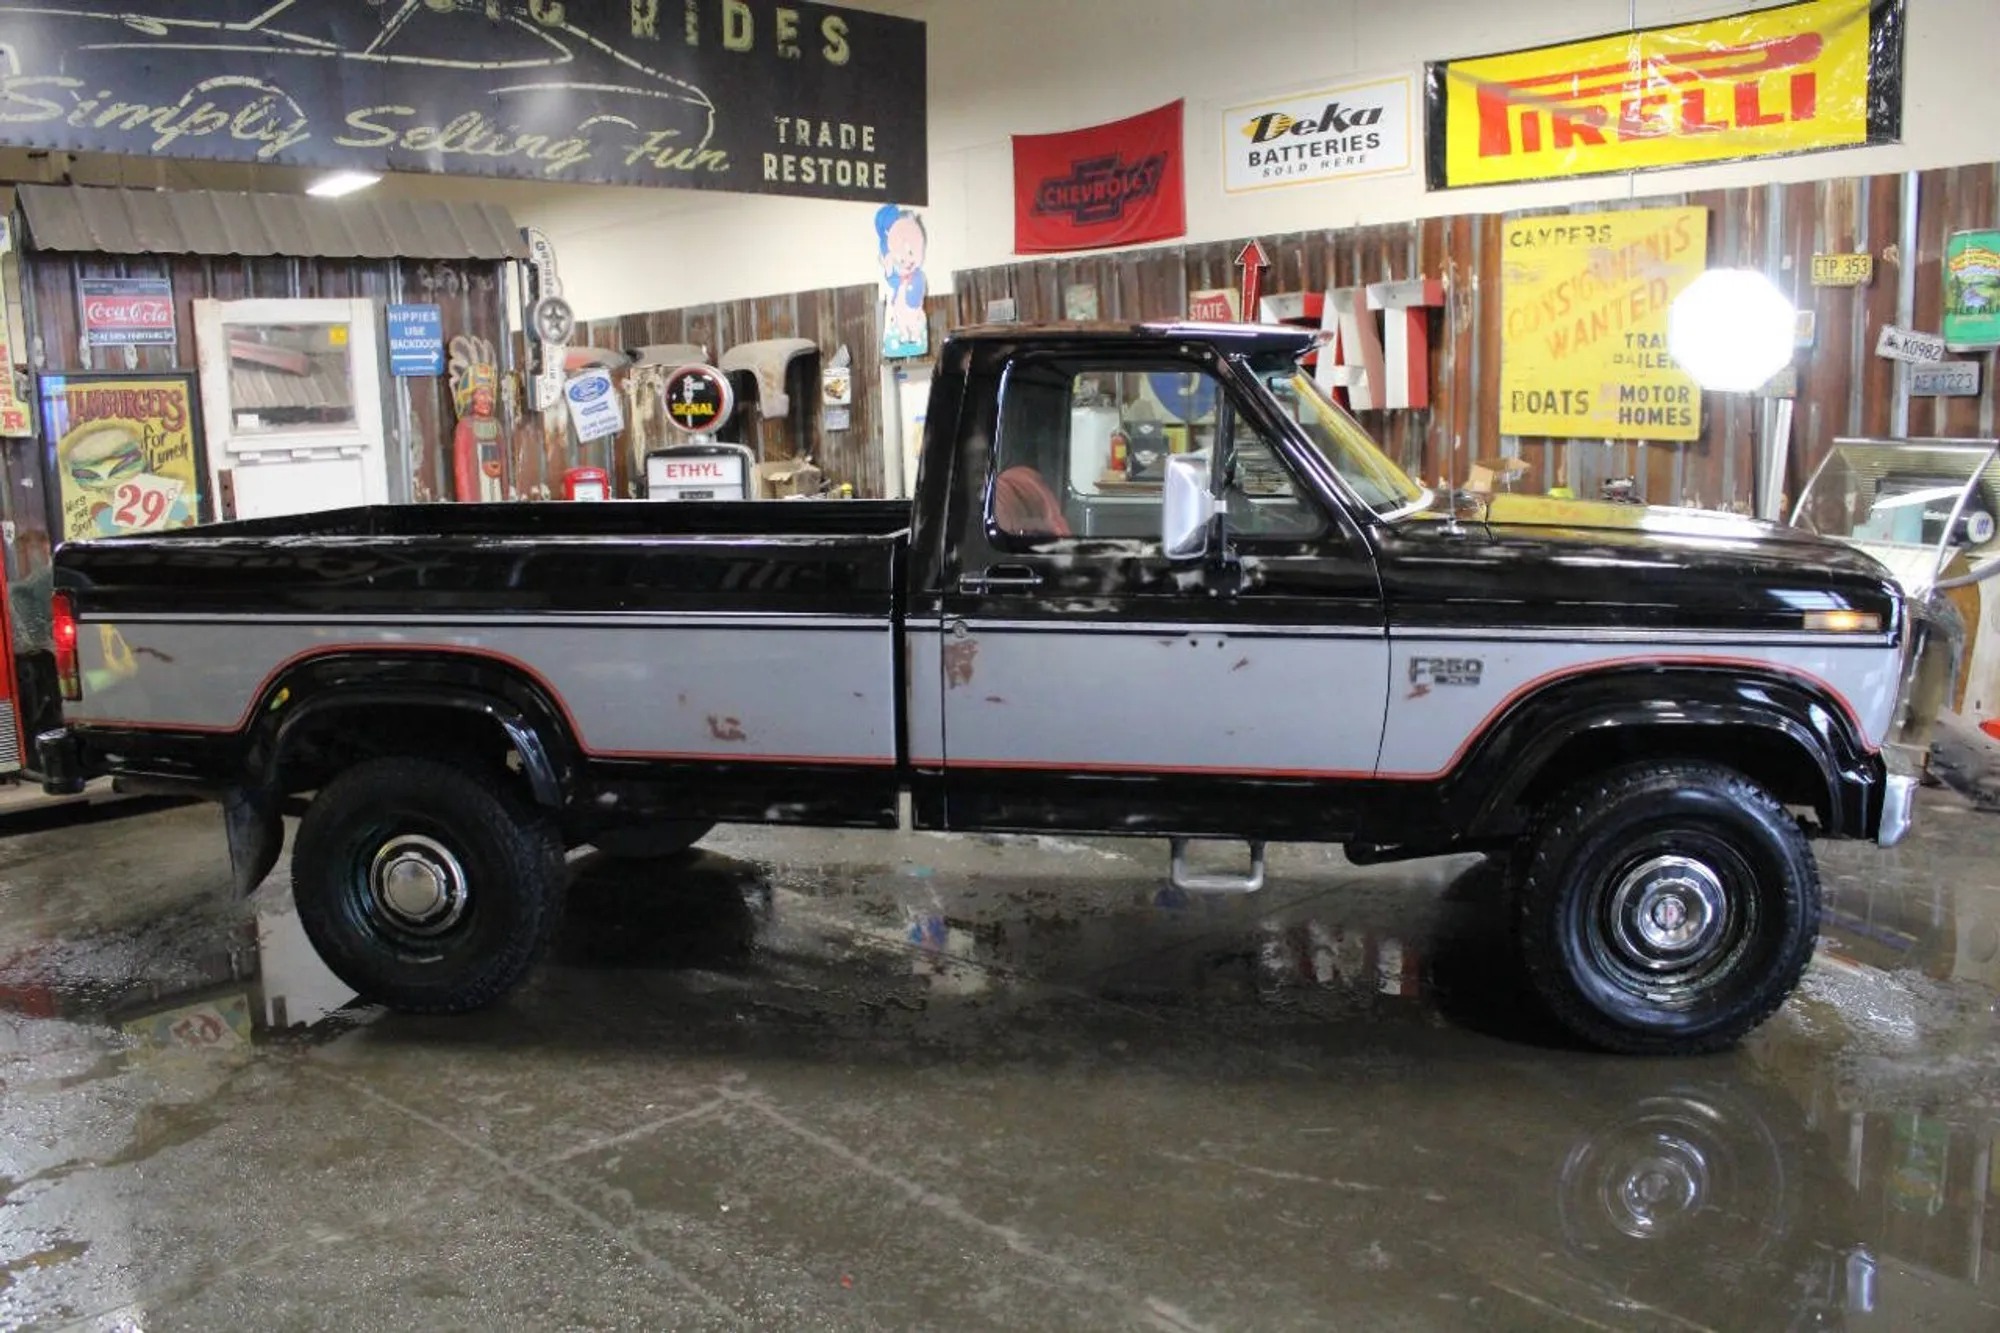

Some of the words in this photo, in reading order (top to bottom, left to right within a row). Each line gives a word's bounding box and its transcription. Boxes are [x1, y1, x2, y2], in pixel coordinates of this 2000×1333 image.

[629, 0, 852, 65] RIDES
[1476, 32, 1823, 157] PIRELLI
[0, 74, 312, 157] Simply
[333, 105, 593, 174] Selling
[622, 129, 731, 172] Fun
[774, 115, 876, 152] TRADE
[1249, 102, 1384, 144] Deka
[1248, 132, 1381, 167] BATTERIES
[1262, 163, 1308, 178] SOLD
[1320, 154, 1367, 170] HERE
[762, 152, 887, 190] RESTORE
[1044, 166, 1156, 206] CHEVROLET
[389, 310, 438, 323] HIPPIES
[1188, 302, 1225, 322] STATE
[1545, 277, 1670, 361] WANTED
[403, 326, 426, 337] USE
[671, 402, 715, 416] SIGNAL
[1511, 390, 1589, 416] BOATS
[1620, 385, 1691, 404] MOTOR
[1618, 407, 1693, 427] HOMES
[666, 461, 724, 478] ETHYL
[114, 484, 166, 528] 29
